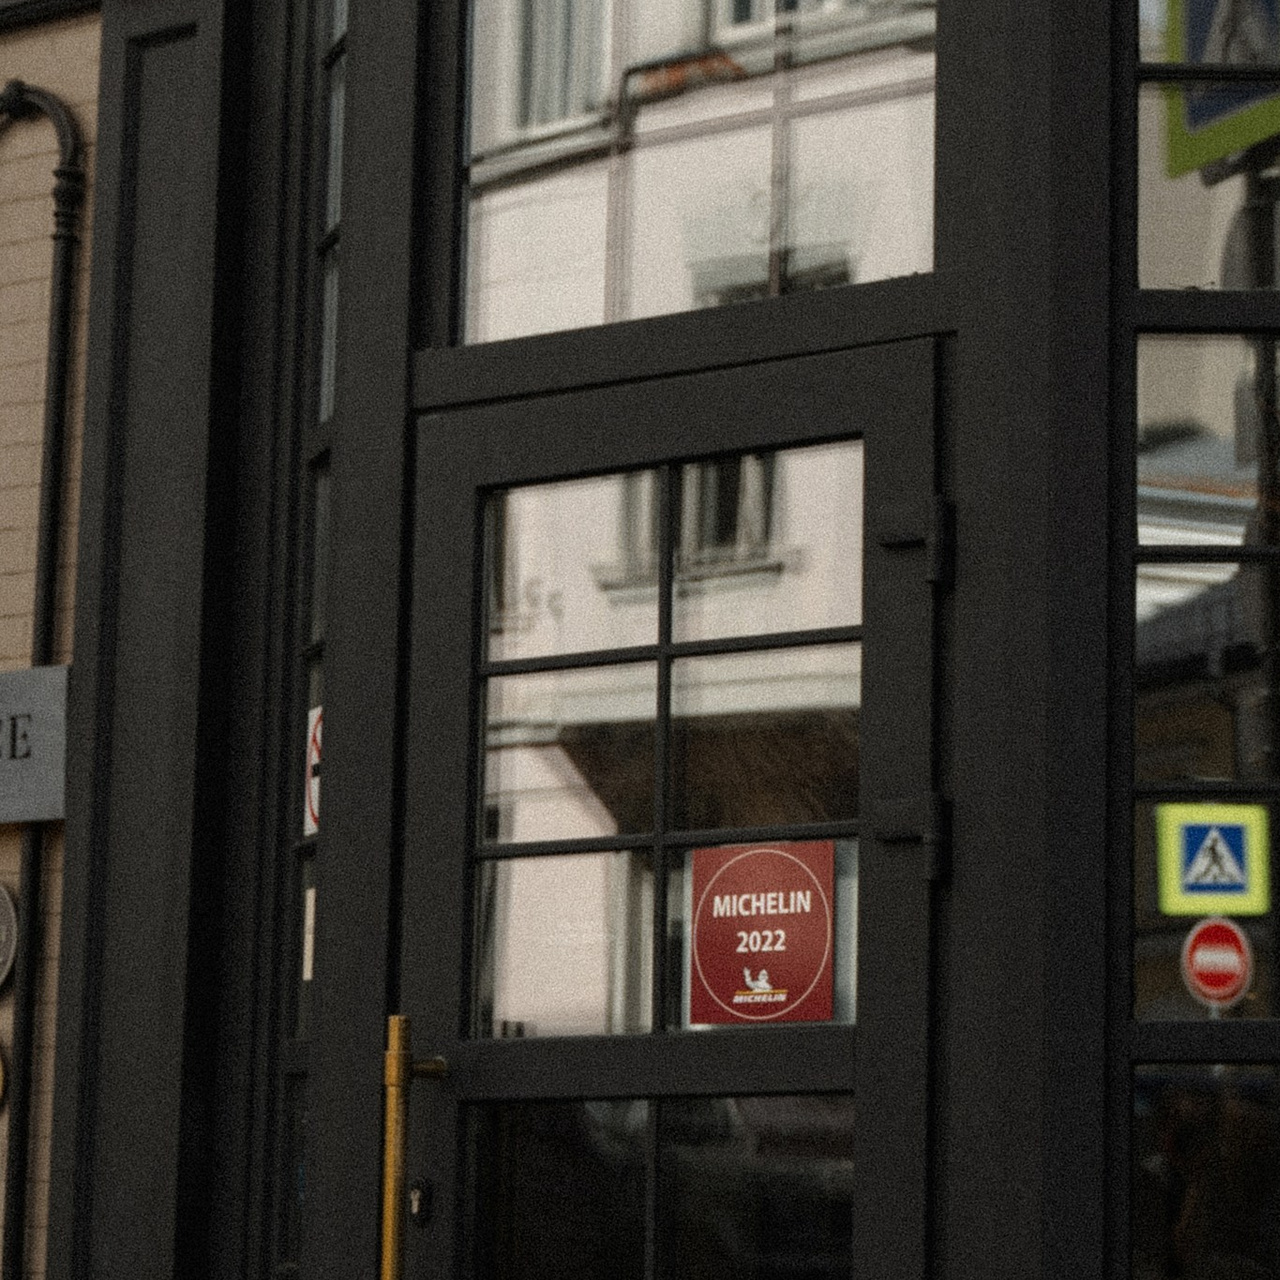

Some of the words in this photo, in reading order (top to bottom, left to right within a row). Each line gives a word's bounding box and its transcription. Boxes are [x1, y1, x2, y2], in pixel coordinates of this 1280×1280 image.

[713, 891, 811, 918] MICHELIN
[736, 929, 786, 953] 2022
[733, 994, 787, 1003] MICHELIN
